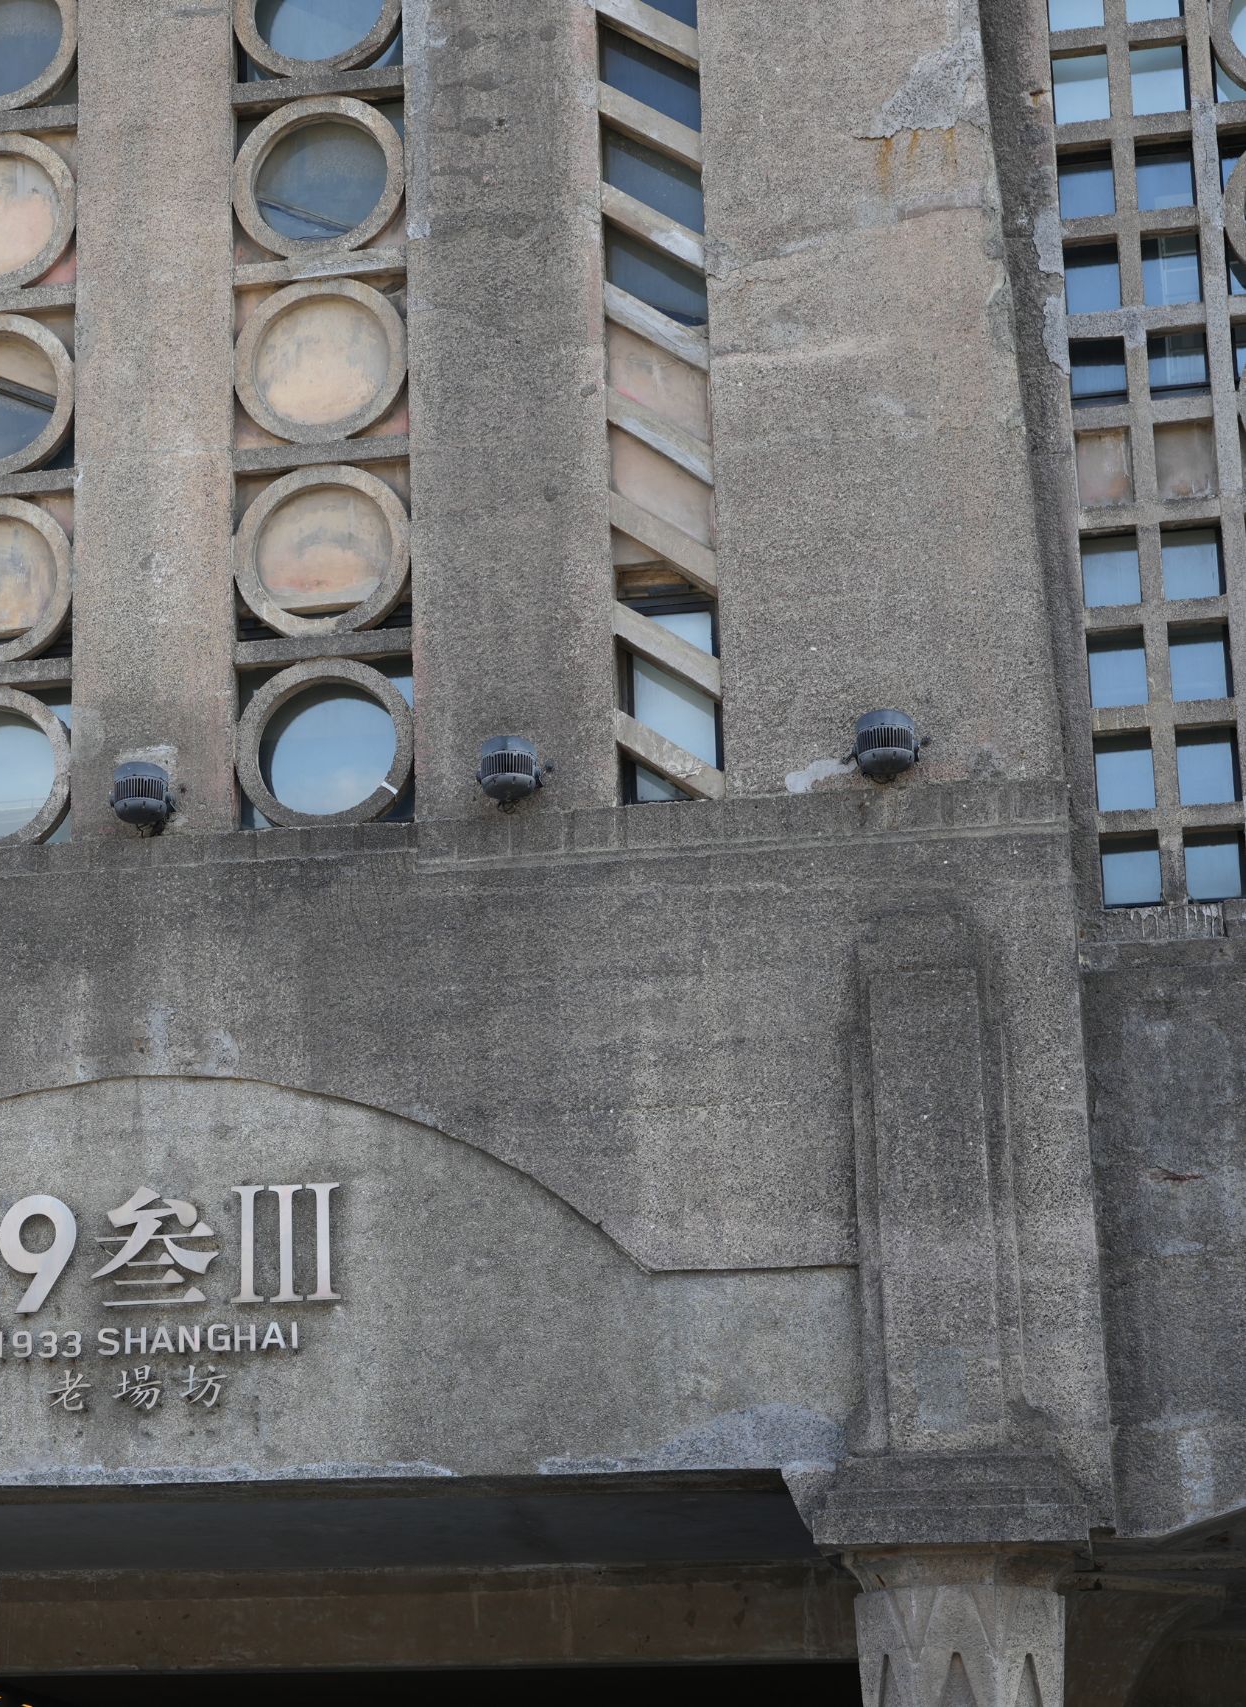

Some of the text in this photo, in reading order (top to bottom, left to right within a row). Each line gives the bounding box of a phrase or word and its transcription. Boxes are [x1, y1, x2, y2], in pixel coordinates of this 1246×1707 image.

[97, 1321, 300, 1357] SHANGHAI
[47, 1364, 228, 1412] 老場坊
